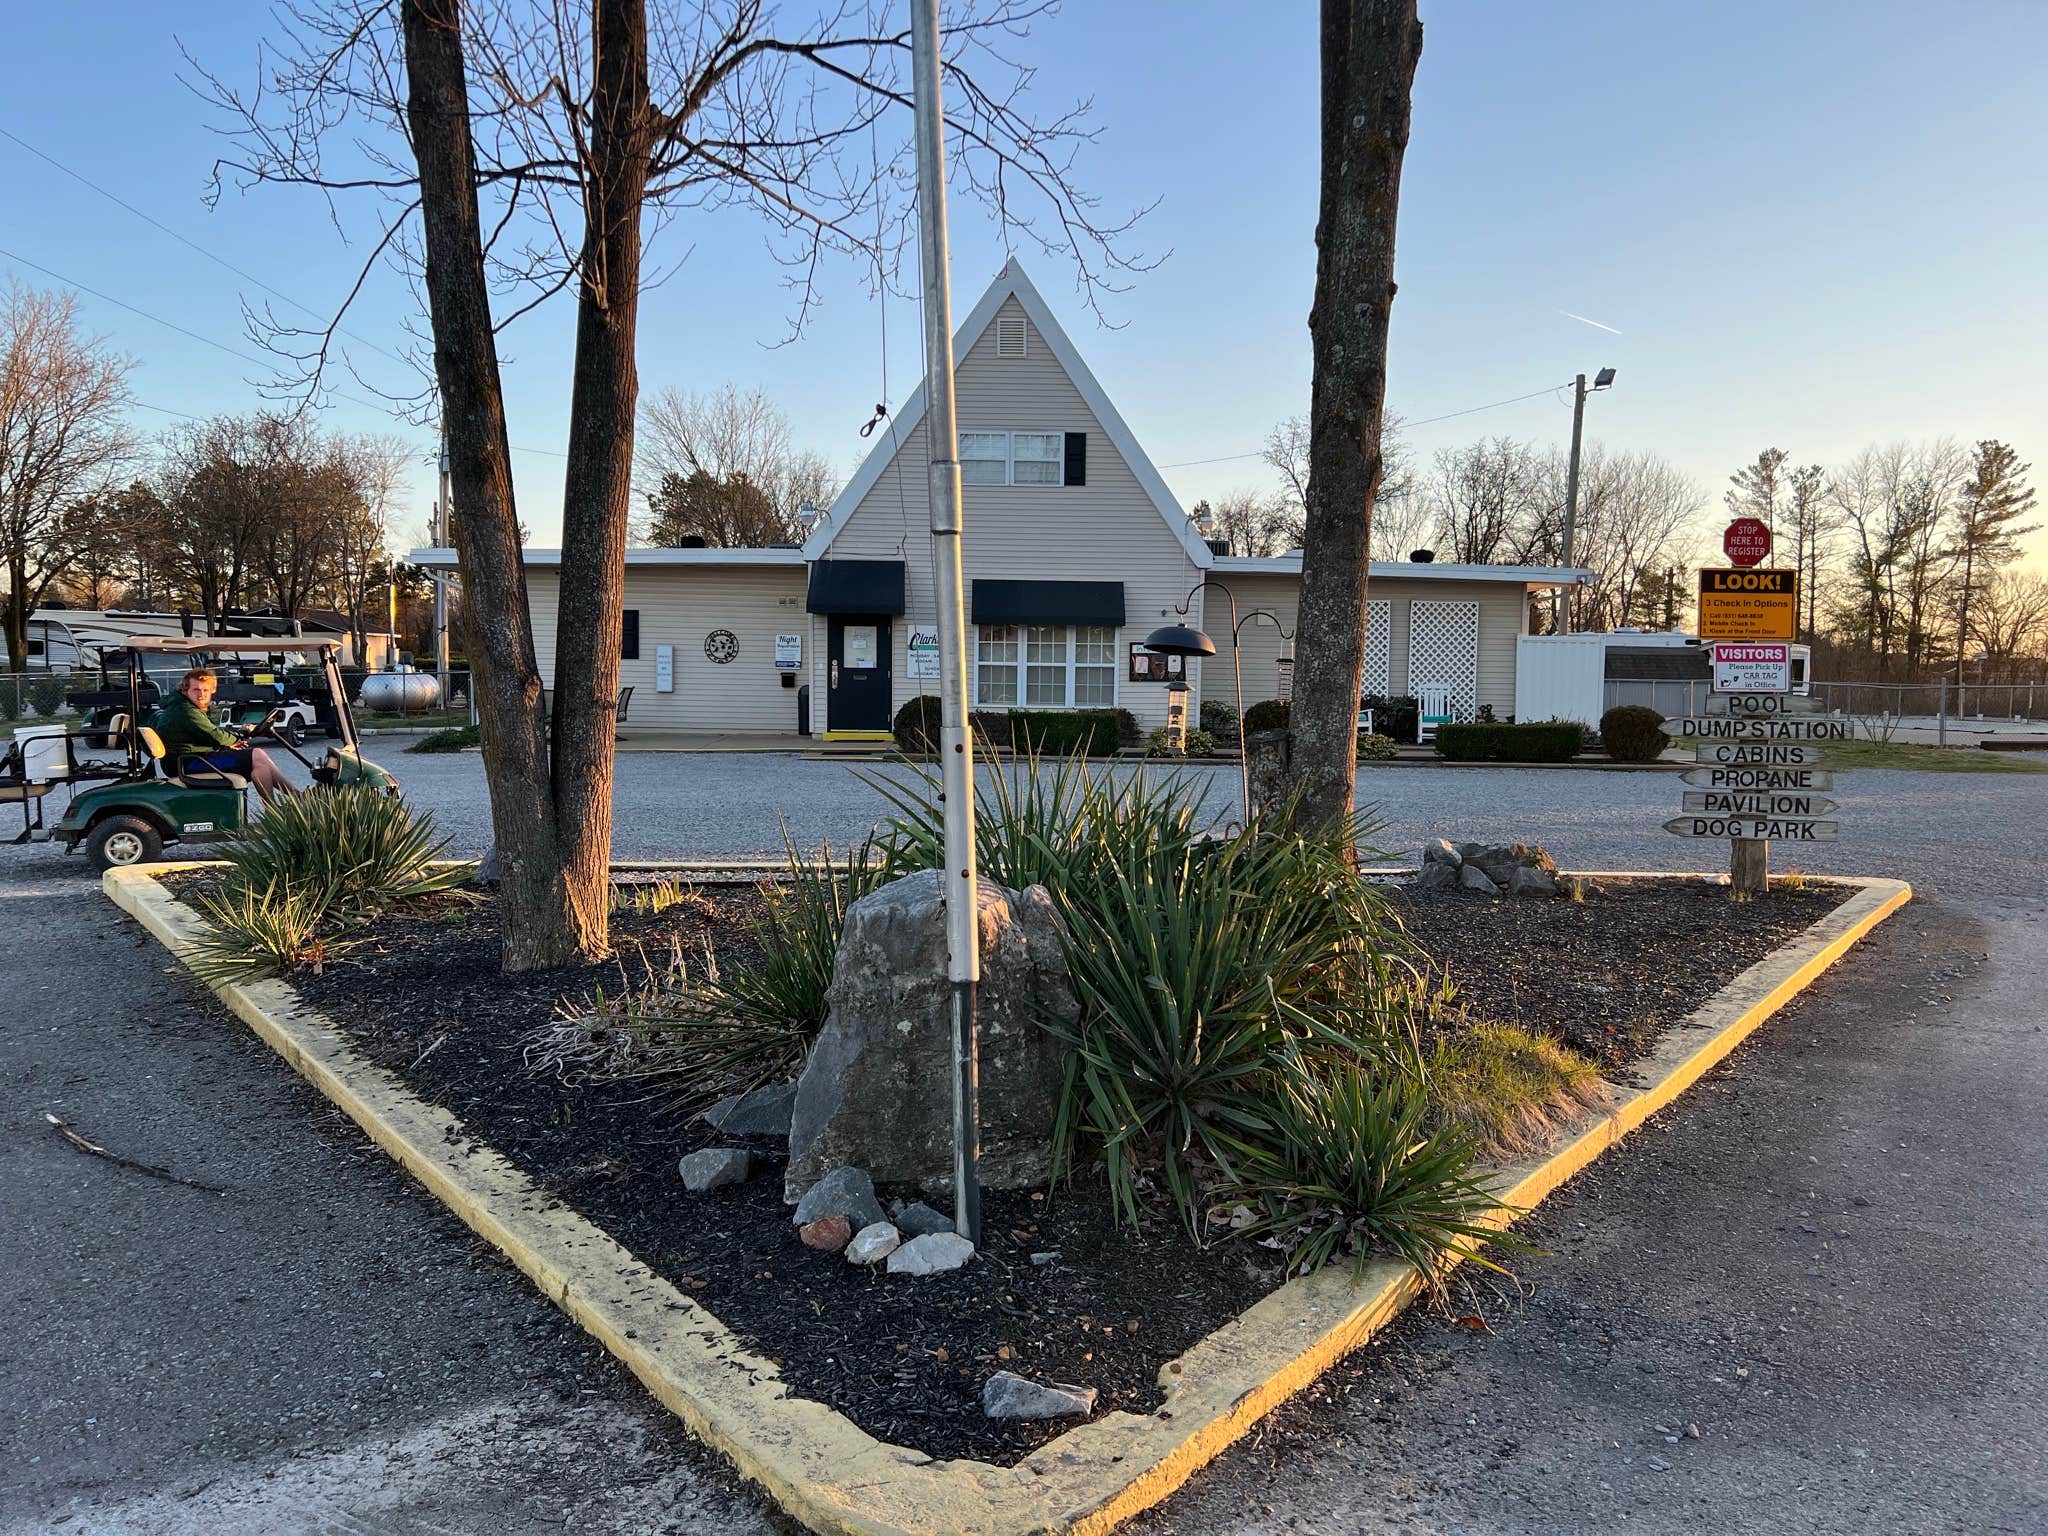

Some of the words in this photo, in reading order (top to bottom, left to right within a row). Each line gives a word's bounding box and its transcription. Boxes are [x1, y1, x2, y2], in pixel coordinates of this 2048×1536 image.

[1738, 526, 1758, 535] STOP
[1730, 536, 1752, 545] HERE
[1753, 536, 1764, 545] TO
[1728, 547, 1766, 556] REGISTER
[1714, 574, 1781, 590] LOOK!
[1753, 600, 1788, 608] Options
[779, 635, 798, 644] Night
[910, 632, 938, 650] Clark
[1719, 648, 1783, 660] VISITORS
[1772, 663, 1784, 671] Up
[1728, 696, 1792, 713] POOL
[1682, 719, 1746, 737] DUMP
[1751, 721, 1845, 739] STATION
[1716, 745, 1804, 763] CABINS
[1711, 769, 1812, 788] PROPANE
[1704, 795, 1810, 814] PAVILION
[1693, 819, 1742, 836] DOG
[1754, 822, 1816, 839] PARK
